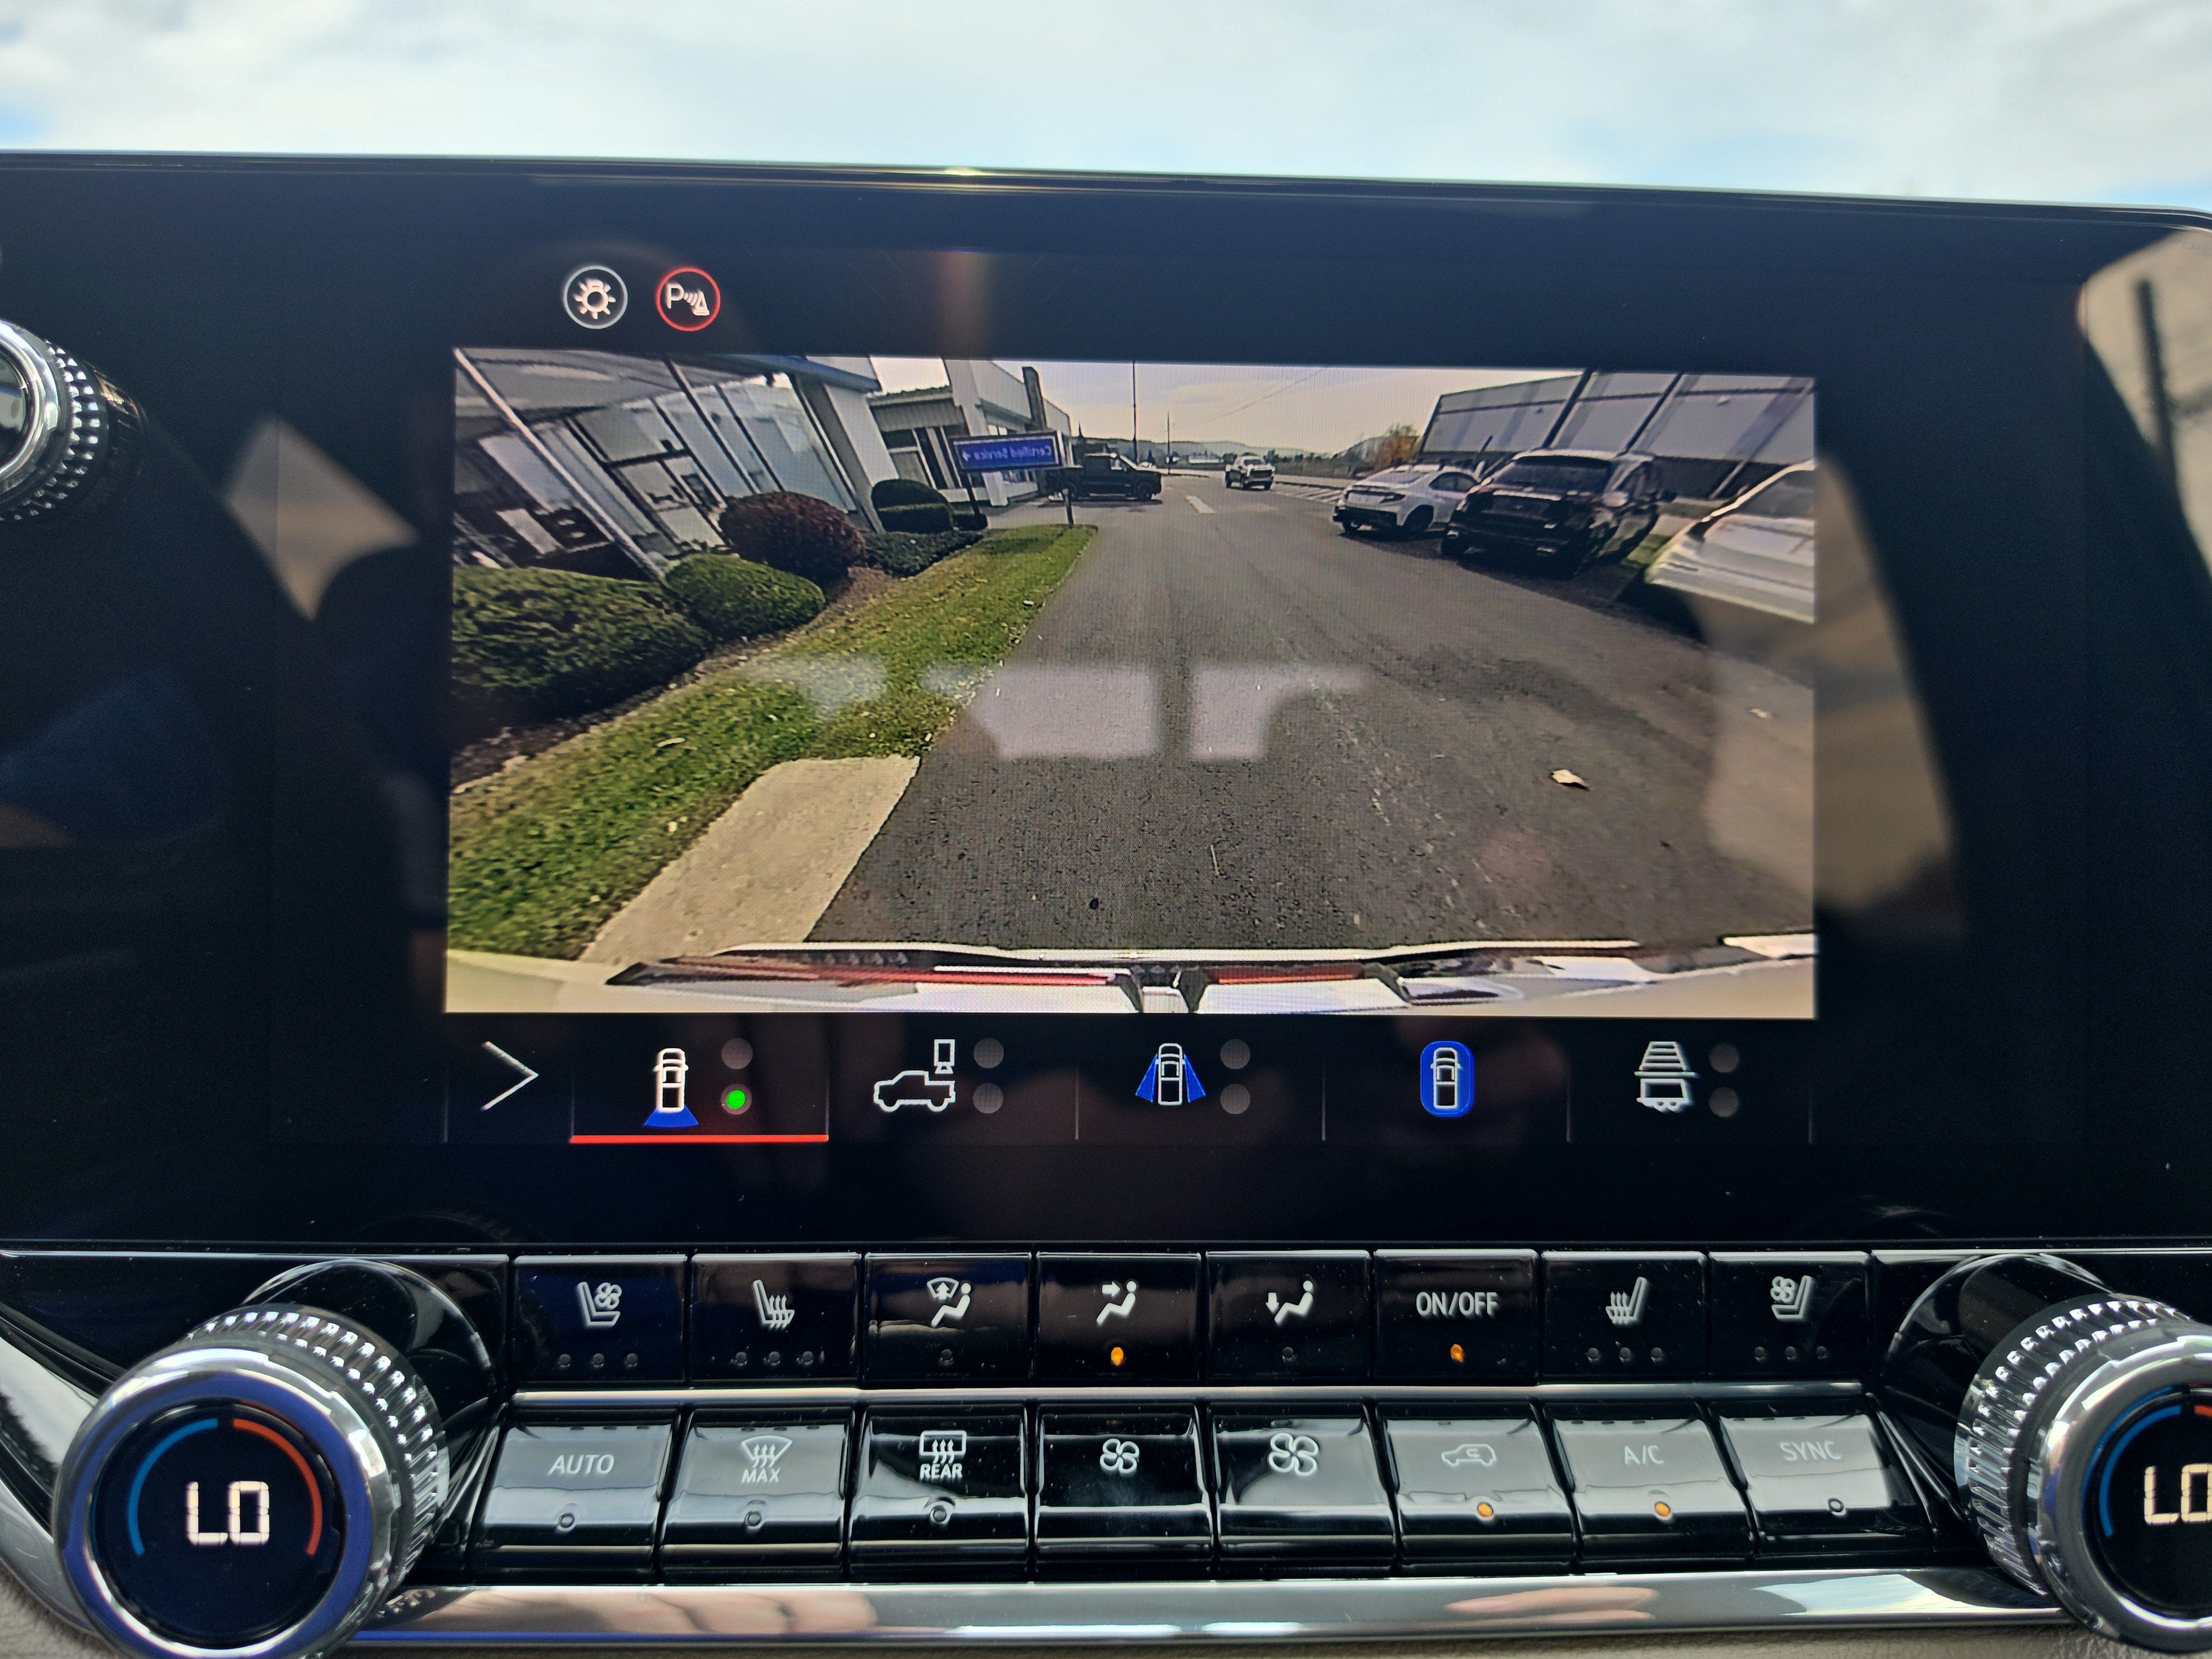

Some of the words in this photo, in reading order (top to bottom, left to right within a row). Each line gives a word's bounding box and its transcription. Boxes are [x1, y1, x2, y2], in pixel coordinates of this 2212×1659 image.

[1416, 1291, 1499, 1317] ON/OFF
[1624, 1444, 1664, 1465] A/C
[1779, 1440, 1843, 1463] SYNC
[549, 1454, 615, 1475] AUTO
[919, 1464, 963, 1480] REAR
[741, 1468, 781, 1484] MAX
